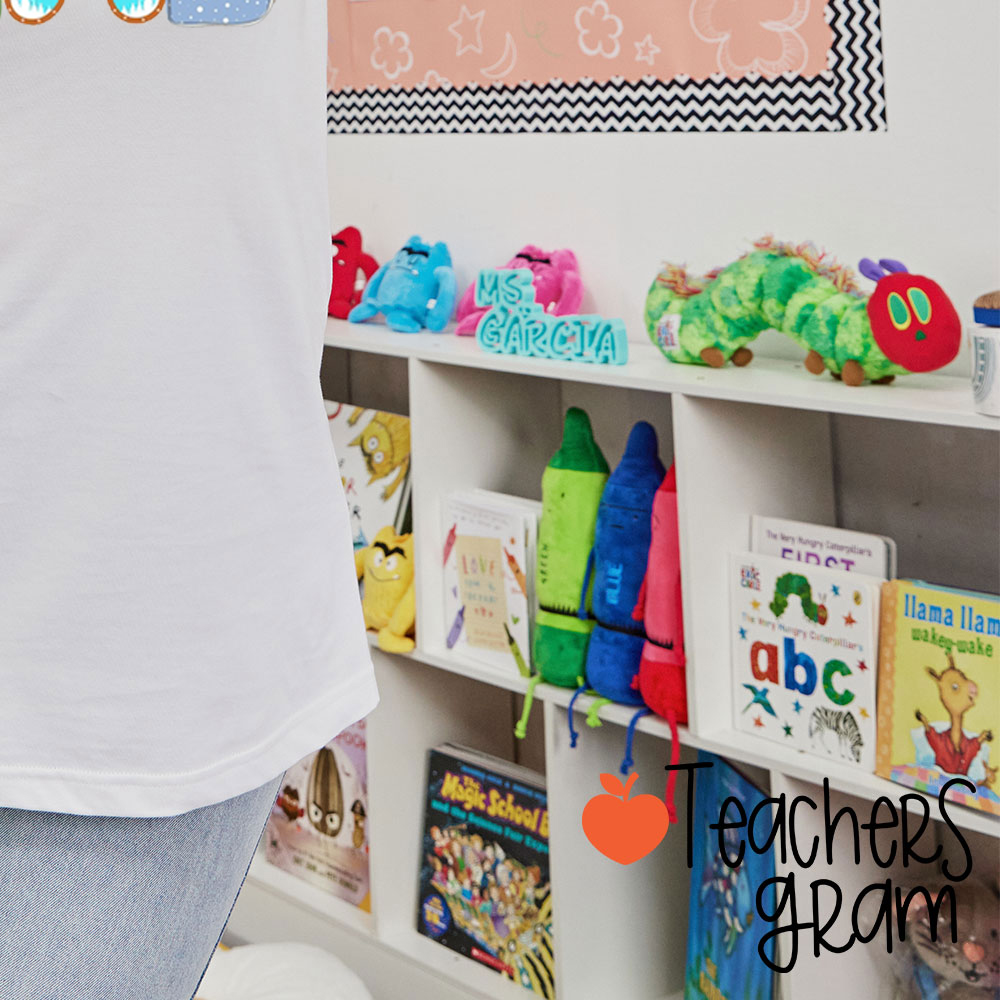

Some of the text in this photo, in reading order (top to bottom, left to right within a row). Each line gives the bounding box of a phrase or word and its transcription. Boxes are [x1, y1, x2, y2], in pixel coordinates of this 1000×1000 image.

[904, 593, 1000, 637] llama llam
[911, 627, 994, 657] wakey-wake
[750, 637, 855, 706] abc
[441, 772, 487, 811] Magic
[487, 789, 541, 832] School
